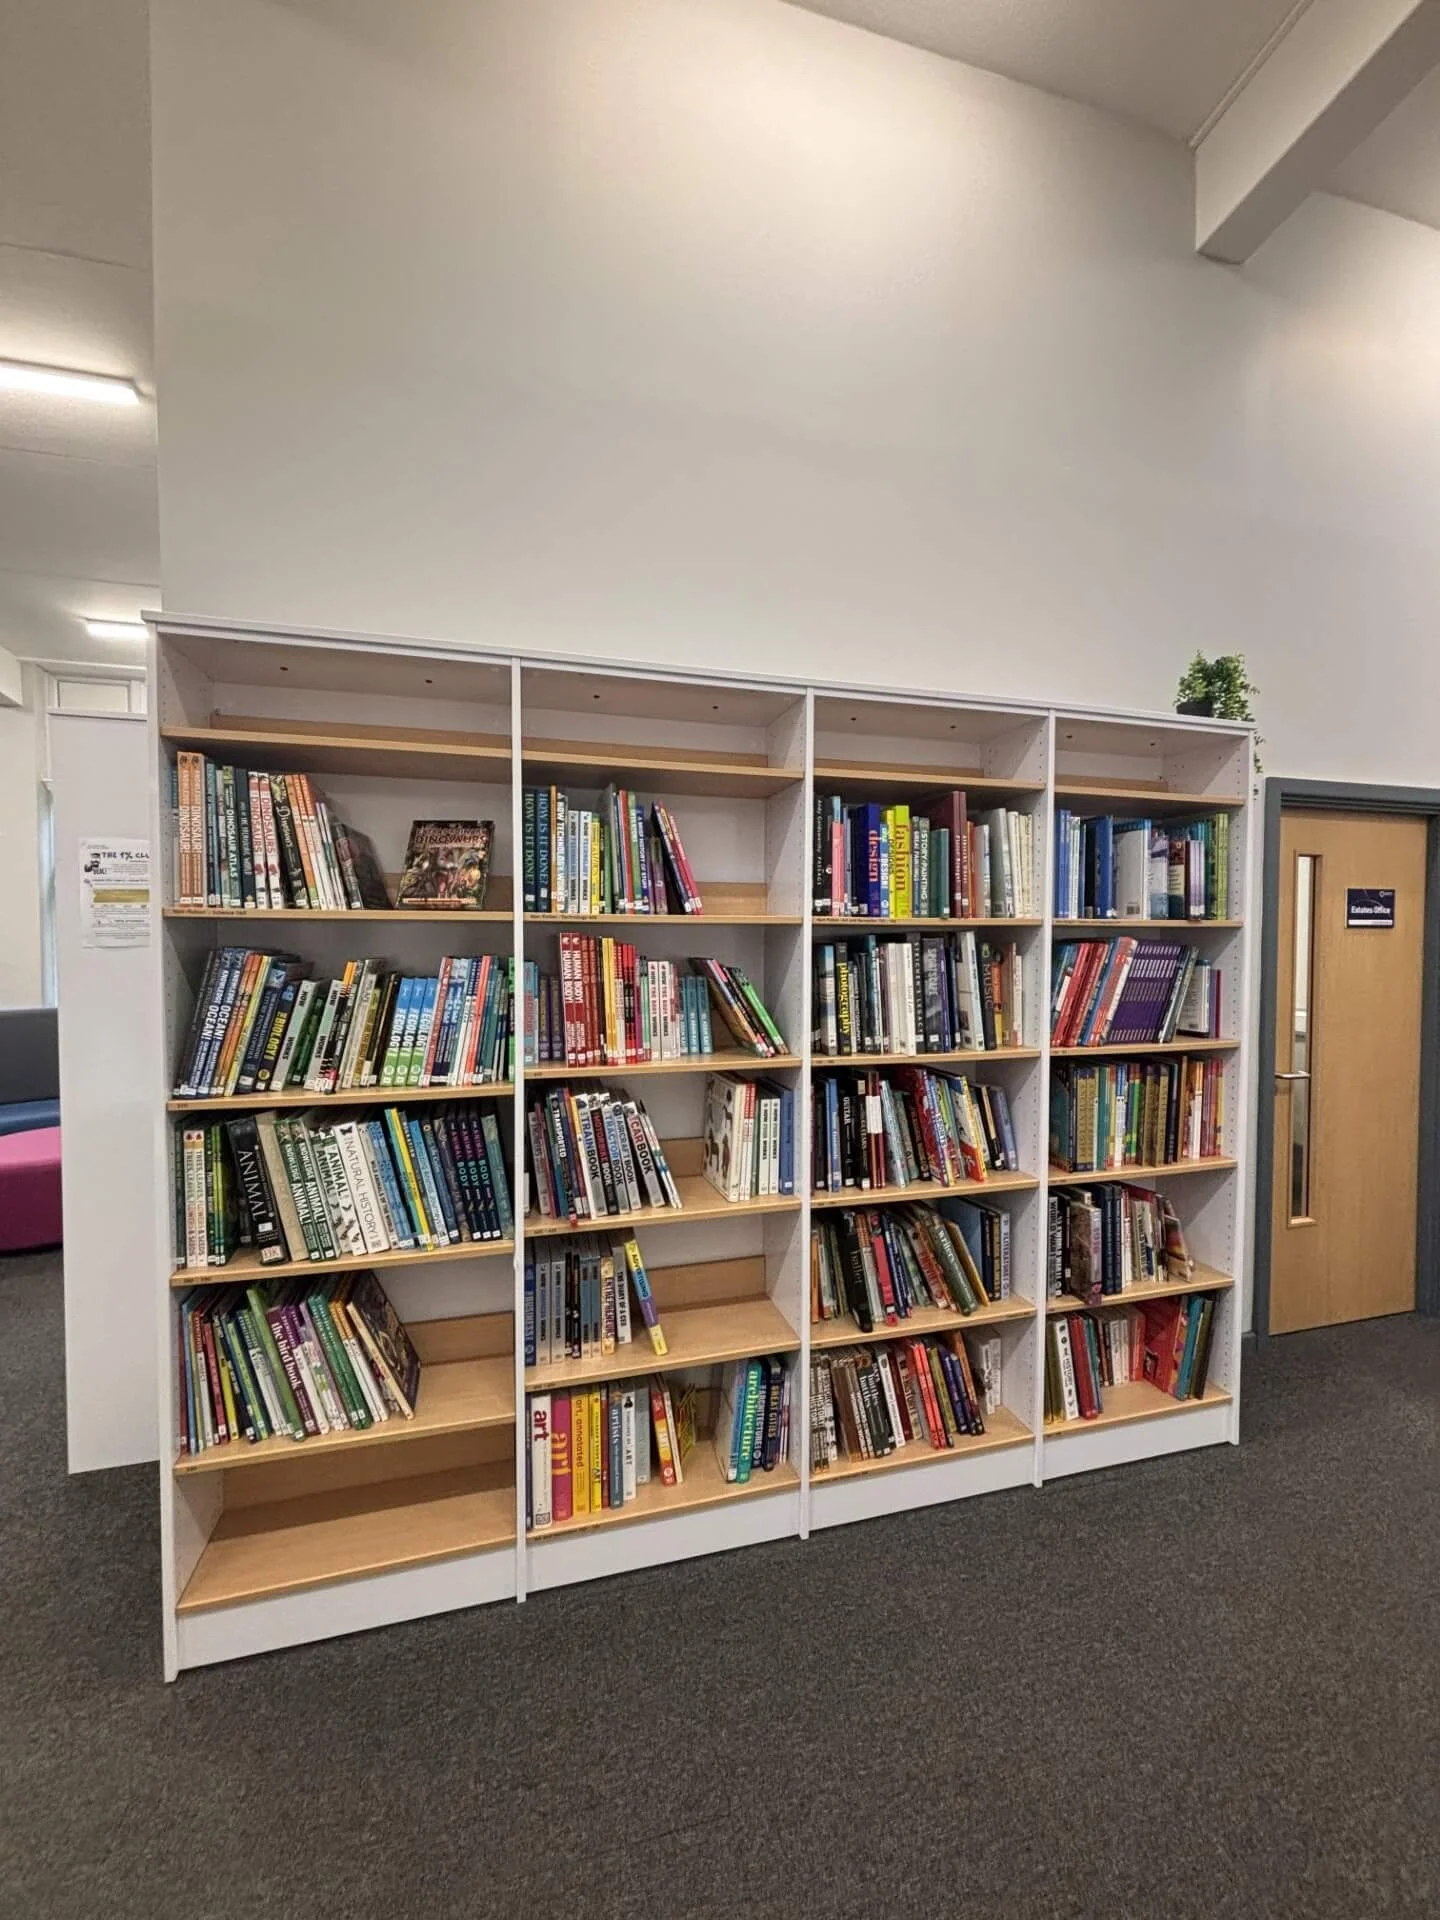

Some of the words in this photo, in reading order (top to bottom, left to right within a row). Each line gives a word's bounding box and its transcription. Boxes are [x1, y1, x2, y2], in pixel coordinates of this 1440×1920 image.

[525, 794, 536, 819] HOW
[539, 794, 550, 819] HOW
[226, 809, 236, 851] DINOSAUR
[251, 798, 262, 853] DINOSAURS
[262, 798, 274, 854] DINOSAURS
[526, 823, 535, 832] IS
[540, 823, 549, 832] IS
[540, 836, 549, 846] IT
[229, 853, 238, 878] ATLAS
[539, 850, 549, 885] DONE?
[868, 830, 881, 882] design
[895, 824, 910, 891] fashion
[1351, 905, 1373, 914] Estates
[1374, 905, 1391, 914] Office
[563, 950, 572, 979] HUMAN
[573, 950, 582, 979] HUMAN
[298, 991, 308, 1007] HOW
[329, 990, 338, 1006] HOW
[564, 981, 573, 1003] BODY!
[575, 981, 583, 1003] BODY!
[837, 962, 851, 1034] photography
[983, 964, 993, 1009] MUSIC
[201, 1005, 218, 1040] OCEAN!
[214, 1005, 230, 1040] OCEAN!
[266, 1018, 287, 1055] BIOLOGY
[388, 1013, 405, 1052] ECOLOGY
[401, 1013, 419, 1052] ECOLOGY
[414, 1013, 432, 1052] ECOLOGY
[282, 1037, 294, 1060] WORKS
[315, 1036, 326, 1058] WORKS
[473, 1128, 485, 1158] ANIMAL
[553, 1109, 566, 1157] TRANSPORTED
[582, 1118, 594, 1149] TRAIN
[605, 1116, 620, 1159] TRACTOR
[630, 1122, 643, 1144] CAR
[637, 1144, 653, 1174] BOOK
[285, 1143, 299, 1181] KNOWLEDGE
[299, 1142, 314, 1180] KNOWLEDGE
[451, 1131, 462, 1160] ANIMAL
[457, 1162, 468, 1187] BODY
[462, 1129, 473, 1159] ANIMAL
[468, 1161, 480, 1187] BODY
[587, 1150, 600, 1180] BOOK
[617, 1120, 630, 1158] AIRCRAFT
[624, 1160, 635, 1184] BOOK
[237, 1150, 267, 1221] ANIMAL
[316, 1150, 334, 1193] ANIMAL
[327, 1152, 347, 1197] ANIMAL
[345, 1141, 364, 1191] NATURAL
[358, 1193, 378, 1234] HISTORY
[478, 1159, 491, 1186] BODY
[602, 1162, 612, 1185] BOOK
[612, 1160, 624, 1186] BOOK
[291, 1183, 313, 1224] ANIMAL!
[305, 1181, 326, 1223] ANIMAL!
[1049, 1201, 1057, 1232] WORLD
[620, 1302, 625, 1310] OF
[271, 1322, 284, 1340] the
[277, 1342, 293, 1362] bird
[285, 1364, 301, 1390] book
[859, 1375, 870, 1408] battles
[868, 1374, 878, 1406] battles
[575, 1399, 584, 1416] art,
[770, 1385, 780, 1410] GREAT
[534, 1410, 549, 1442] art
[612, 1409, 620, 1444] artists
[741, 1370, 760, 1460] architecture
[768, 1412, 777, 1438] CITIES
[552, 1432, 572, 1476] art
[576, 1419, 585, 1468] annotated
